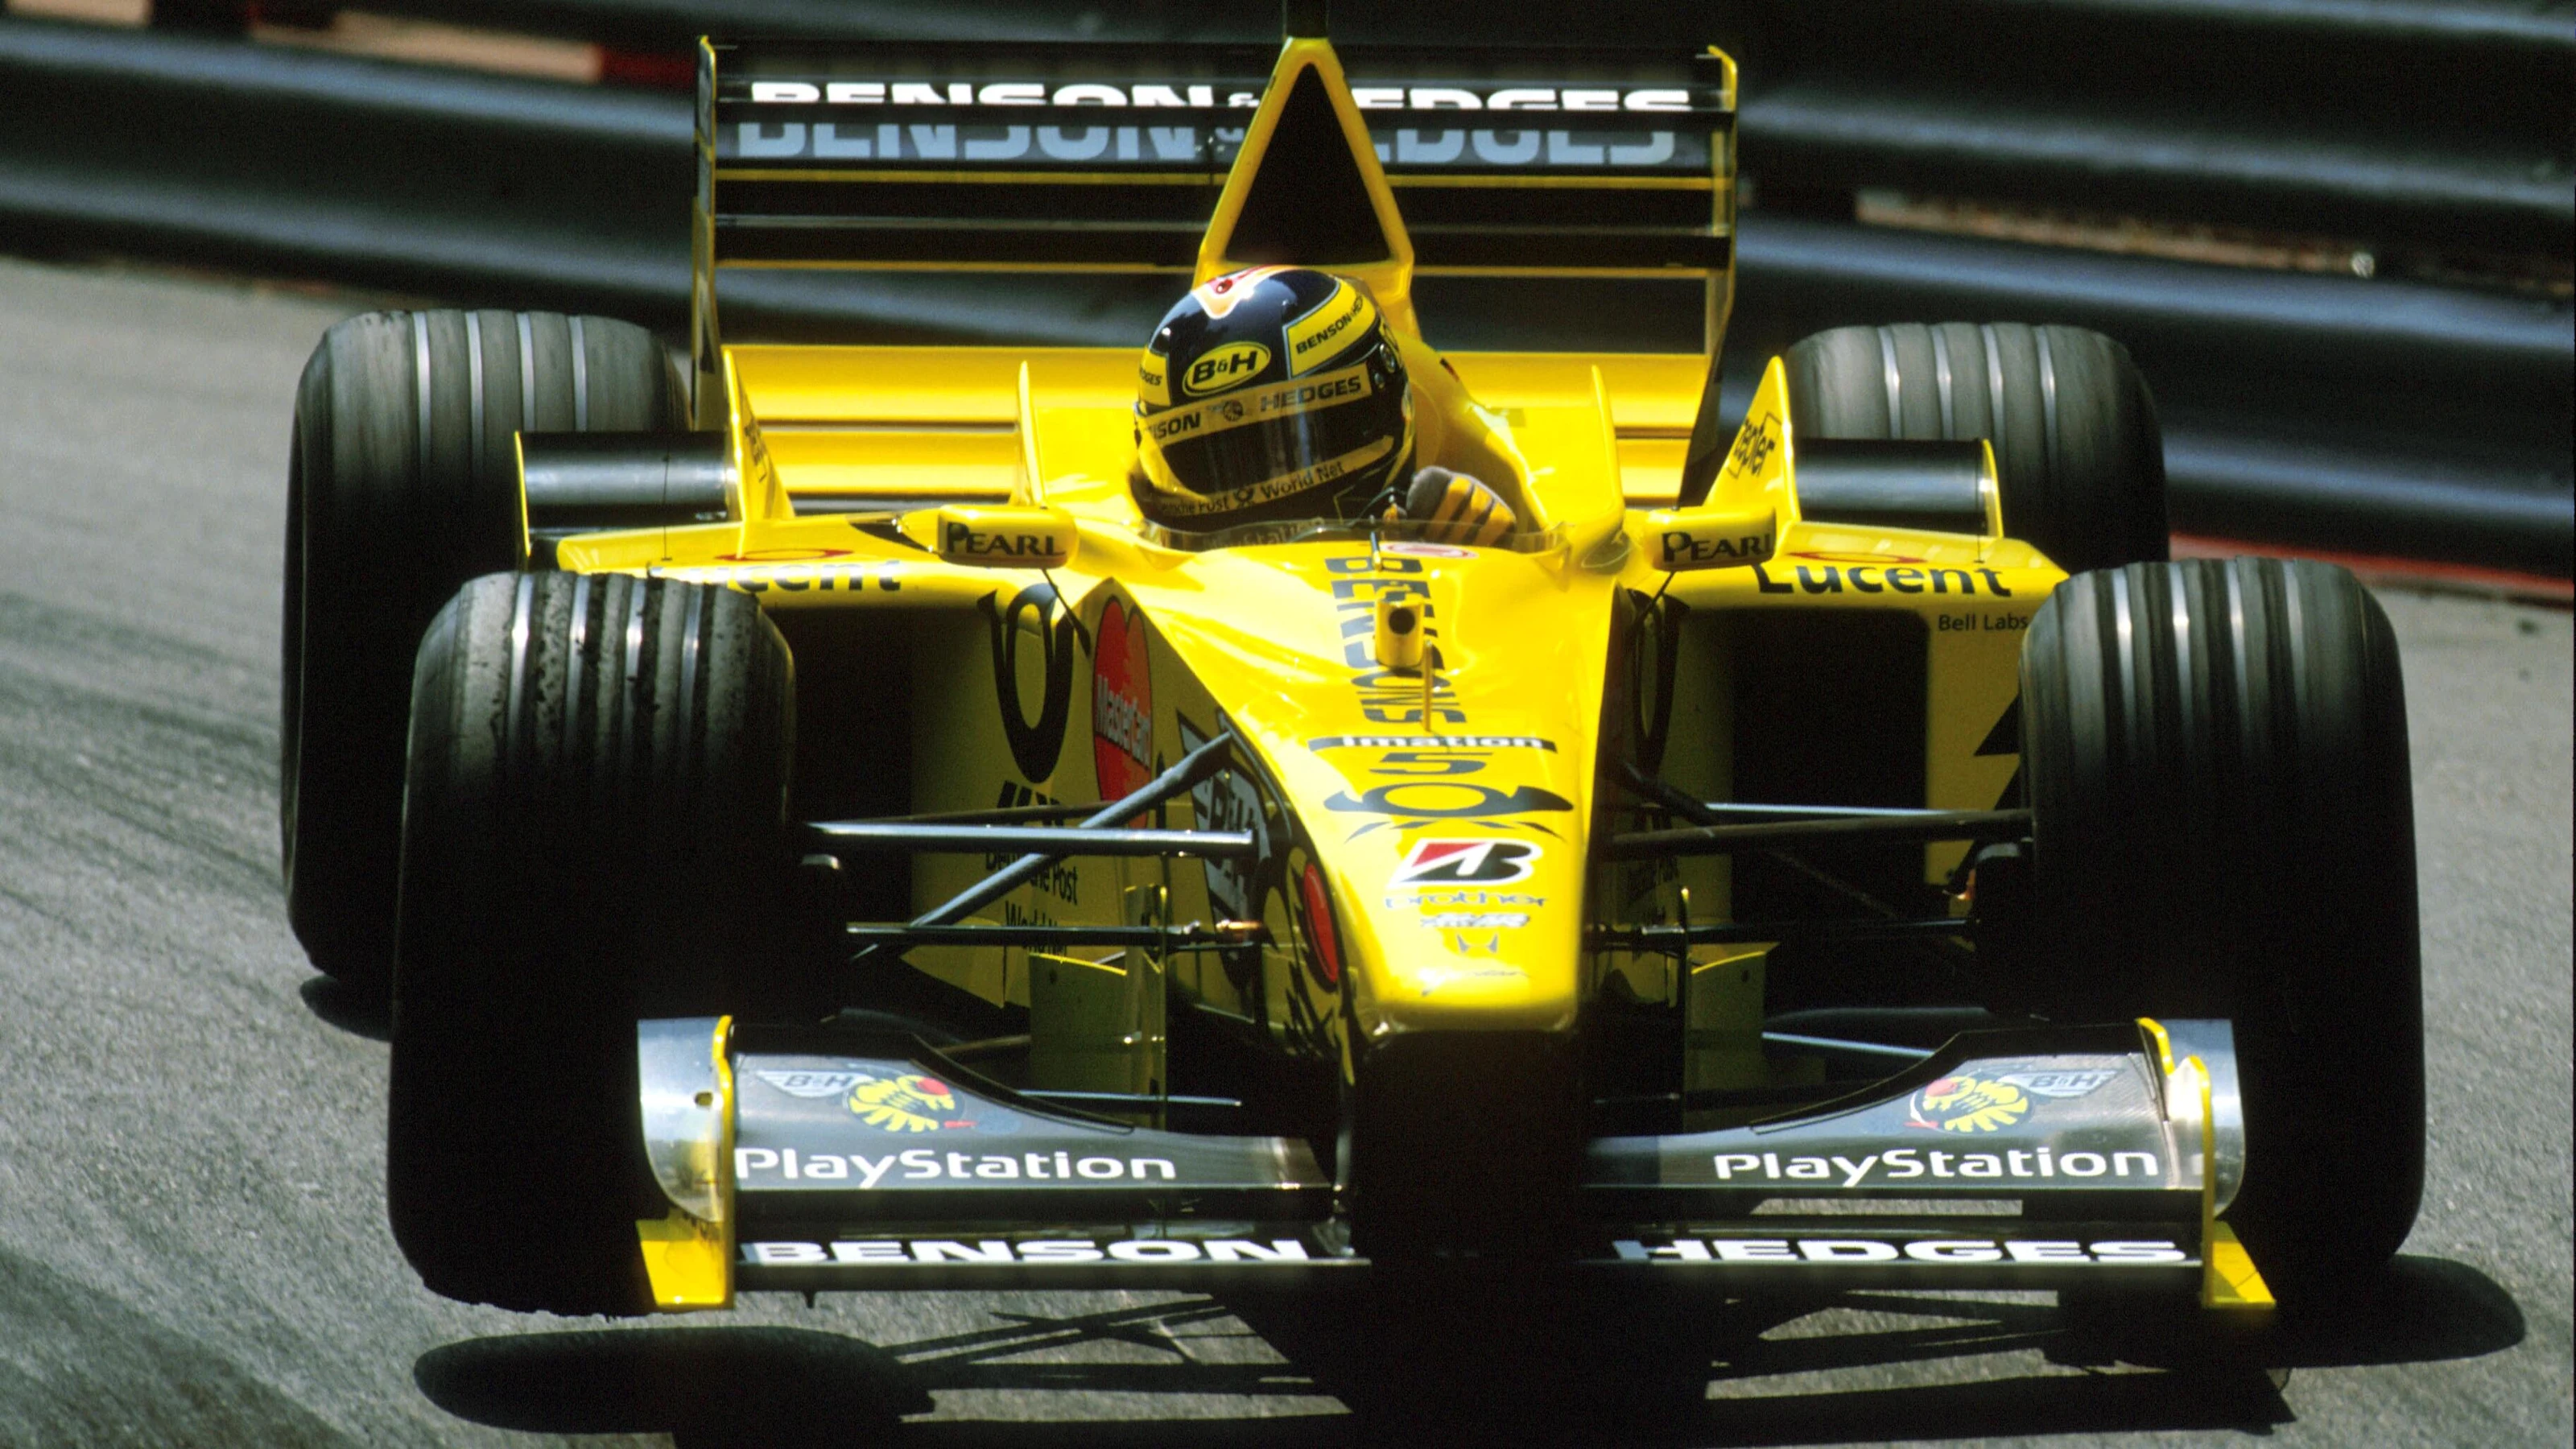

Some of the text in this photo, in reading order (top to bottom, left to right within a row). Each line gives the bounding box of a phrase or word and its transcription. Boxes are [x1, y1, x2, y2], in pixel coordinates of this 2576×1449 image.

[1352, 88, 1689, 166] EDGES
[1296, 312, 1352, 354] BENSON
[1192, 349, 1258, 385] B&H
[1260, 375, 1361, 414] HEDGES
[1260, 477, 1314, 500] World
[1317, 460, 1345, 482] Net
[946, 521, 1067, 557] PEARL
[1752, 564, 2012, 598] Lucent
[1938, 614, 2029, 631] Bell Labs
[1368, 752, 1493, 775] 5
[733, 1147, 1177, 1189] PlayStation
[1713, 1146, 2161, 1187] PlayStation
[741, 1239, 1309, 1265] BENSON
[1612, 1239, 2187, 1264] HEDGES
